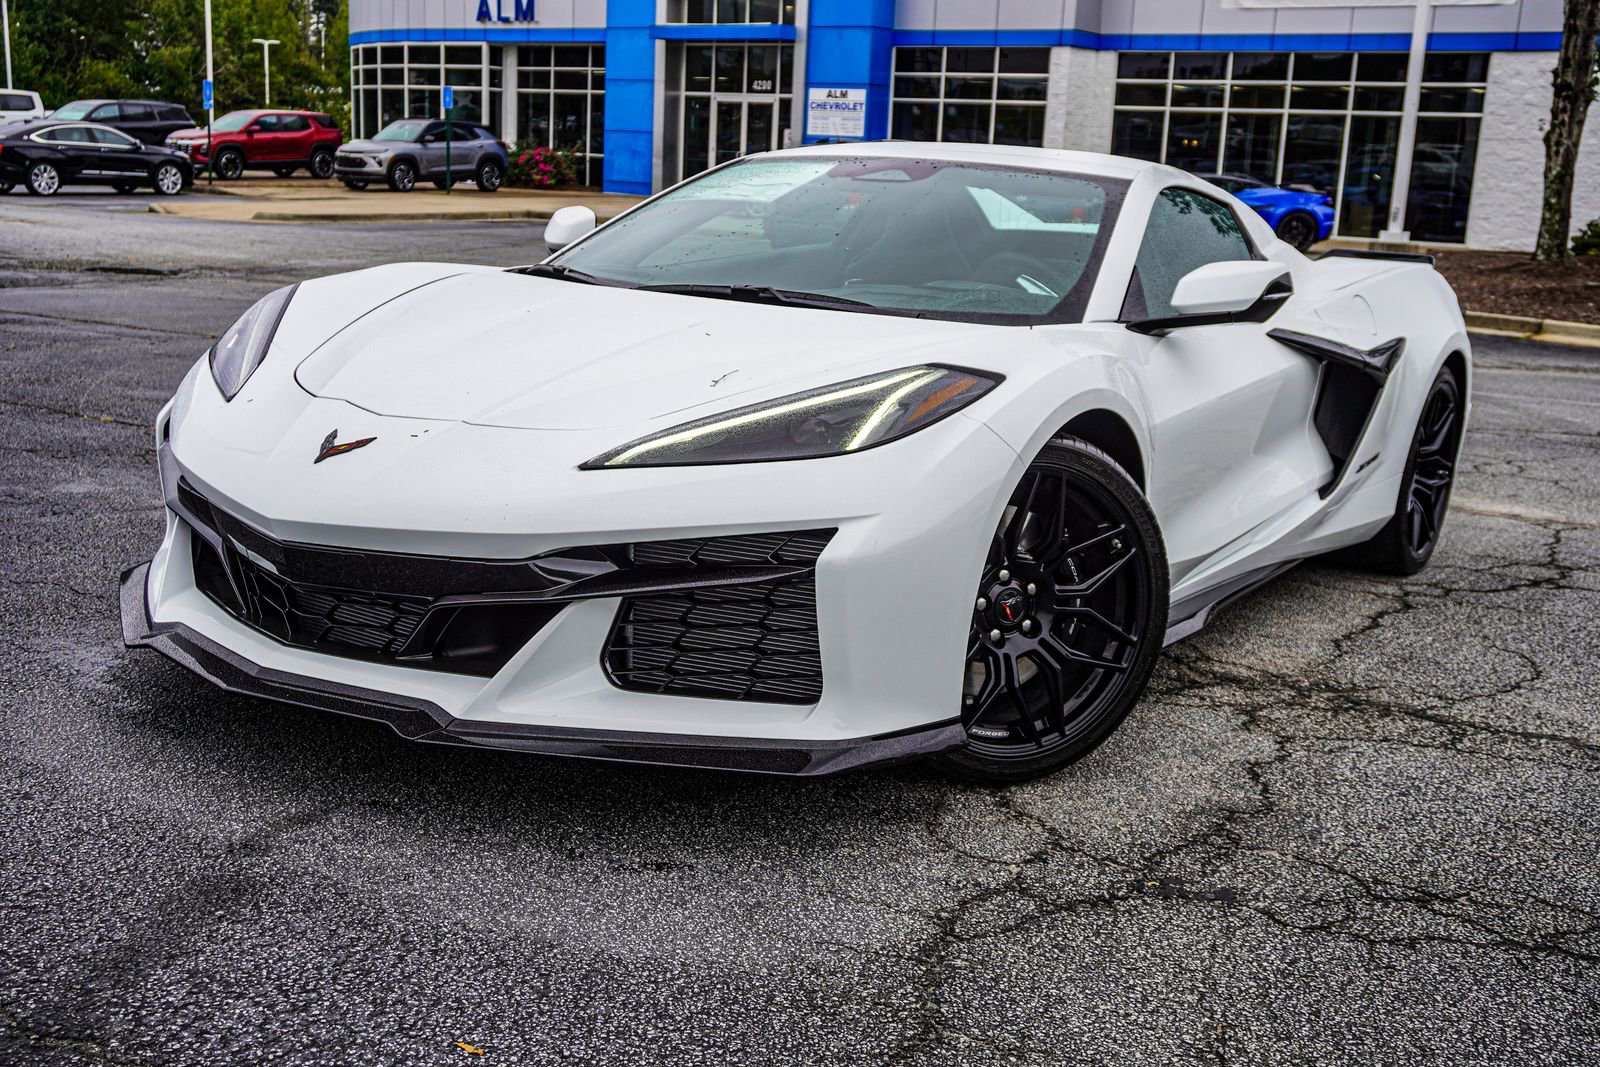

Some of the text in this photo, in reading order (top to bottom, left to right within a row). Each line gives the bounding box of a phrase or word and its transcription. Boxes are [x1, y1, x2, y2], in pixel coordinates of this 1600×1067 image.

[476, 0, 536, 22] ALM
[826, 89, 848, 98] ALM
[810, 101, 864, 110] CHEVROLET
[971, 728, 1010, 738] FORGED
